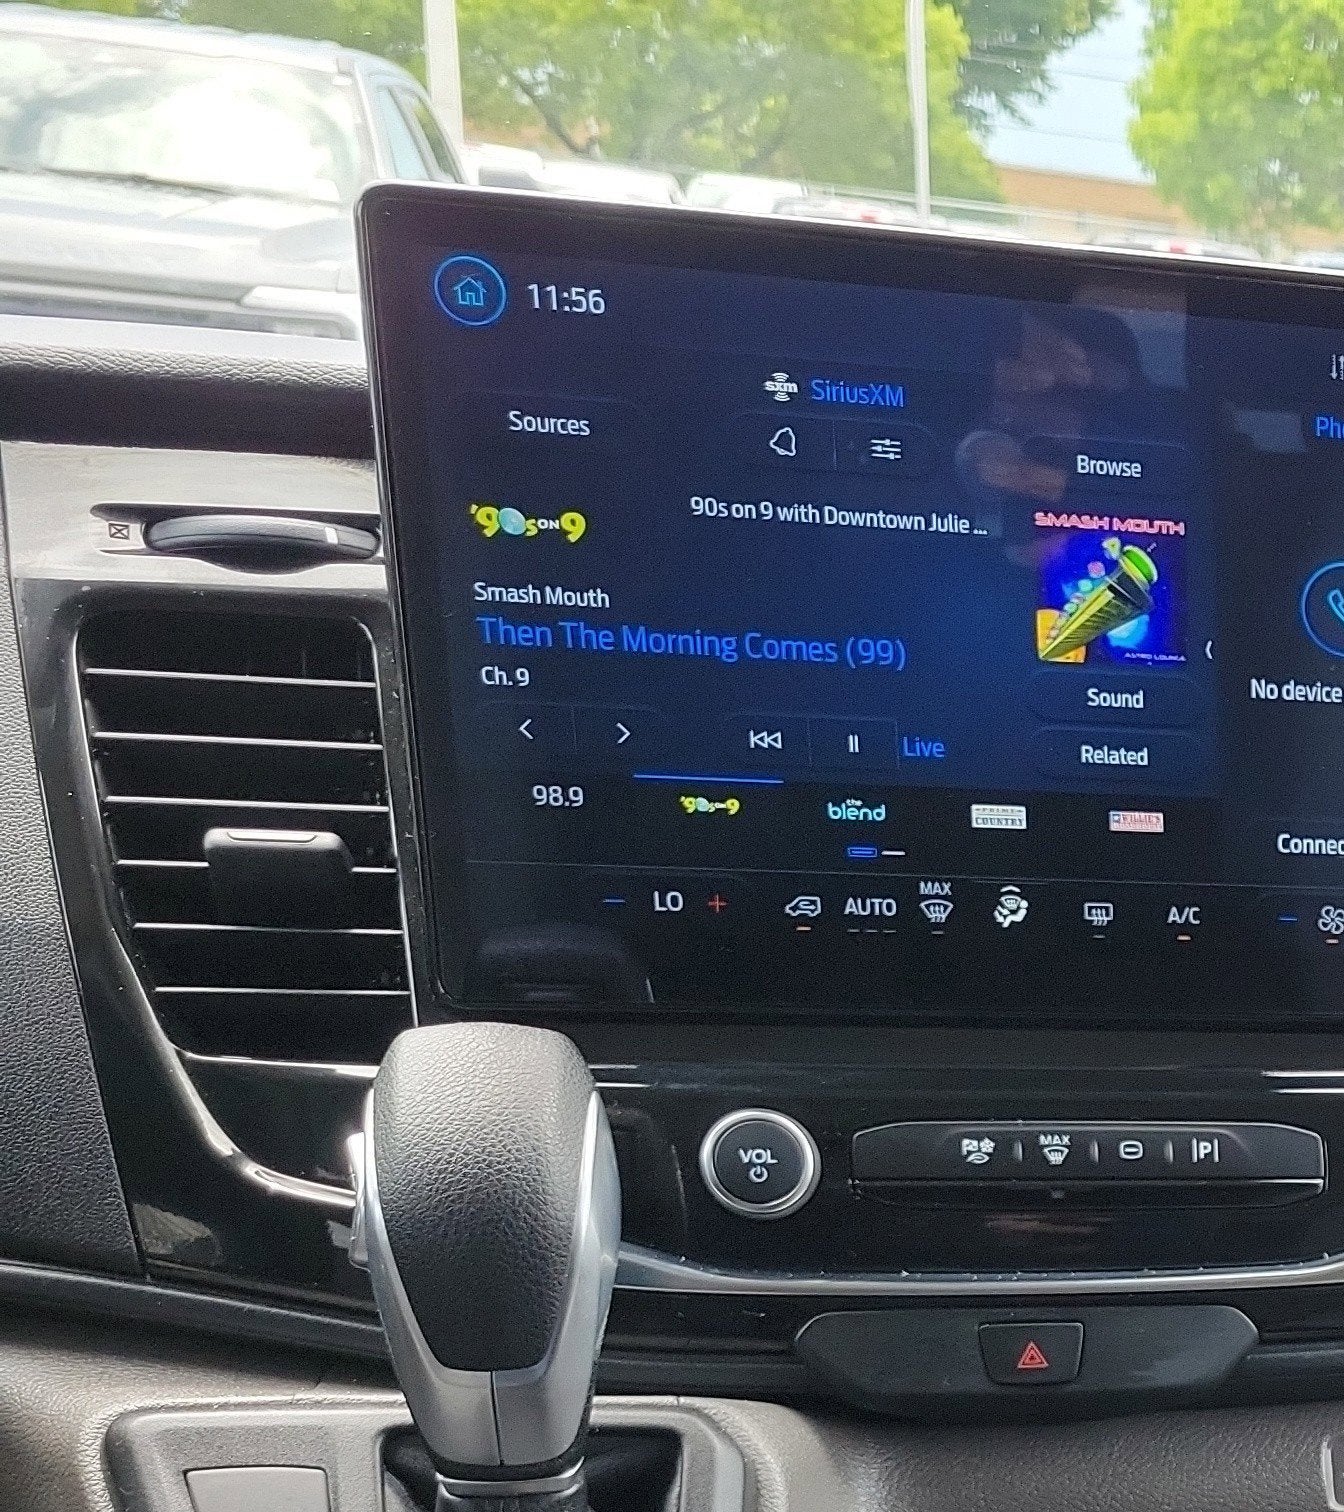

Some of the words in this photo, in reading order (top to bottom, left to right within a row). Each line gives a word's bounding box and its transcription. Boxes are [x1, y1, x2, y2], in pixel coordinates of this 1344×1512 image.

[526, 281, 605, 316] 11:56
[810, 378, 905, 408] SiriusXM
[508, 410, 590, 437] Sources
[1076, 455, 1142, 479] Browse
[690, 496, 728, 517] 90s
[731, 501, 757, 520] on
[759, 501, 774, 520] 9
[776, 503, 820, 524] with
[824, 505, 925, 531] Downtown
[928, 513, 970, 534] Julie
[1034, 511, 1110, 531] SMASH
[1112, 517, 1186, 536] MOUTH
[473, 582, 542, 605] Smash
[545, 586, 610, 608] Mouth
[476, 616, 554, 648] Then
[558, 621, 615, 651] The
[621, 625, 739, 663] Morning
[744, 632, 839, 663] Comes
[845, 634, 907, 671] (99)
[480, 665, 513, 687] Ch.
[516, 668, 530, 687] 9
[1087, 688, 1144, 710] Sound
[1250, 679, 1279, 700] No
[1281, 680, 1343, 704] device
[903, 736, 945, 759] Live
[1080, 744, 1149, 767] Related
[532, 785, 584, 807] 98.9
[827, 802, 886, 822] blend
[975, 817, 1023, 827] COUNTRY
[919, 882, 952, 896] MAX
[653, 891, 684, 912] LO
[843, 898, 898, 917] AUTO
[1167, 906, 1201, 926] A/C
[1039, 1134, 1071, 1147] MAX
[738, 1148, 777, 1165] VOL
